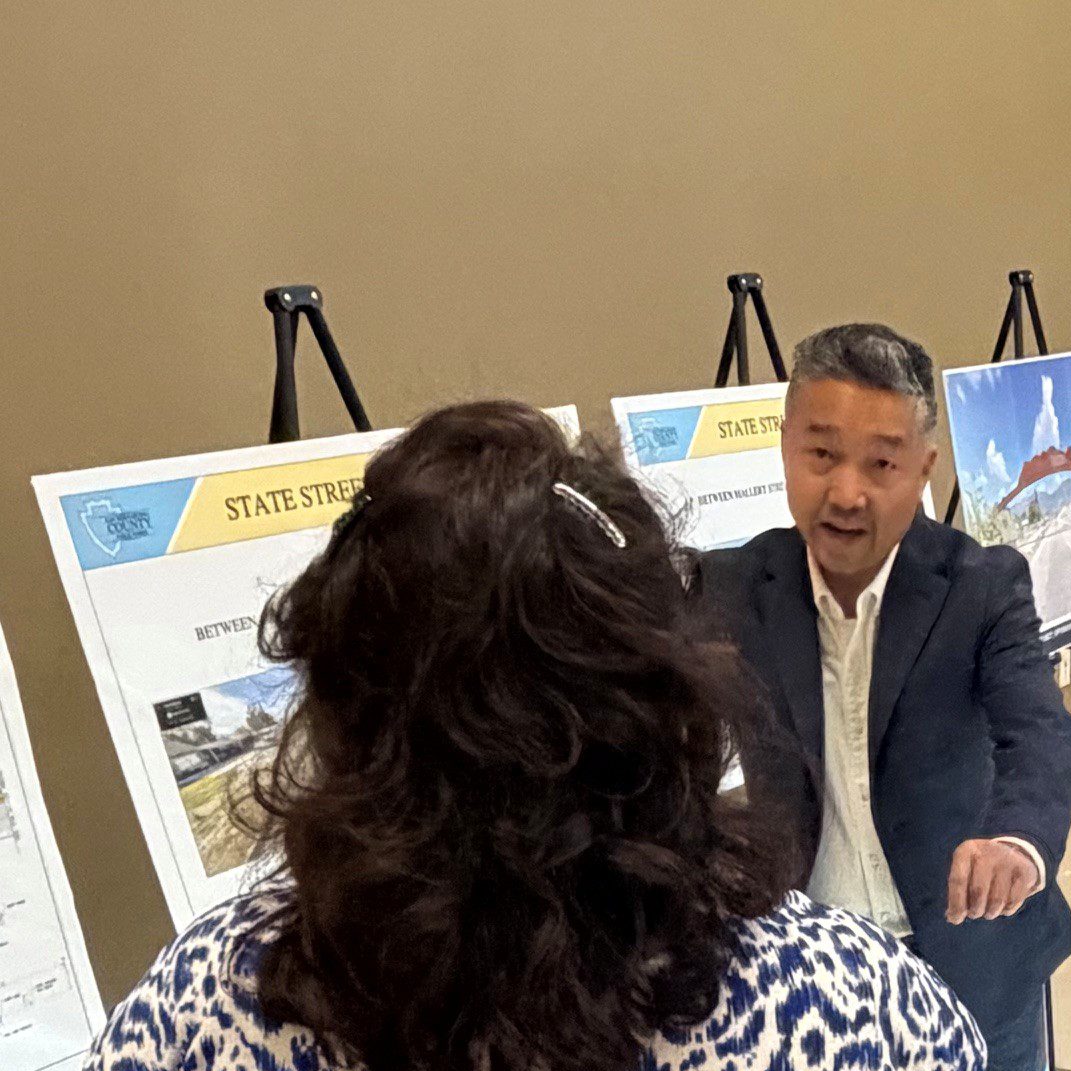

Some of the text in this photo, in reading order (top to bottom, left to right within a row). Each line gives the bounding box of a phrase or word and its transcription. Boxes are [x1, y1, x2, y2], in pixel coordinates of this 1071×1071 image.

[717, 414, 785, 439] STATE STR
[224, 488, 298, 521] STATE
[697, 491, 734, 506] BETWEEN
